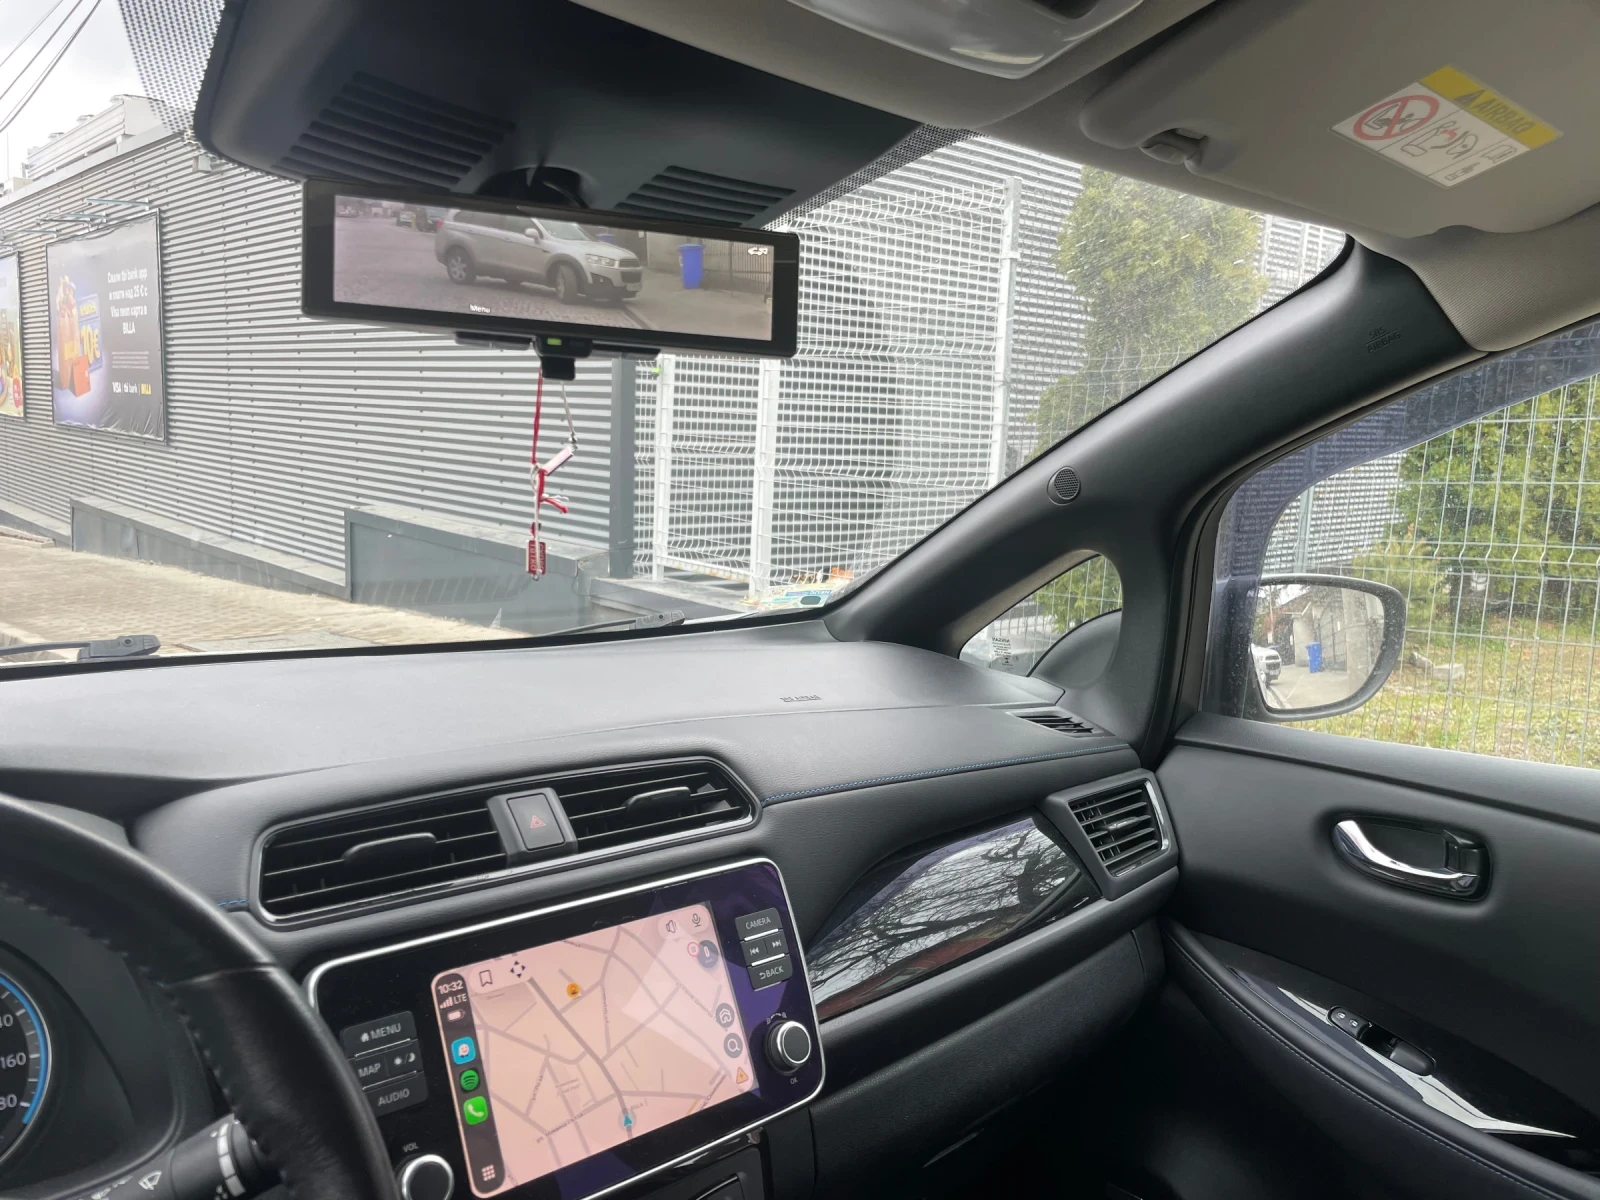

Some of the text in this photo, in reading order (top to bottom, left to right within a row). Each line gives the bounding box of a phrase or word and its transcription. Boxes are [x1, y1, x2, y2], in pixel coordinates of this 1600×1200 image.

[1472, 98, 1535, 134] AIRBAG
[470, 304, 491, 314] Menu
[122, 321, 136, 334] BILLA
[745, 916, 771, 930] CAMERA
[766, 965, 784, 978] BACK
[438, 980, 464, 995] 10:32
[453, 993, 468, 1004] LTE
[370, 1023, 402, 1040] MENU
[0, 1052, 26, 1069] 160
[358, 1063, 381, 1078] MAP
[790, 1077, 798, 1085] OK
[378, 1088, 410, 1106] AUDIO
[402, 1142, 419, 1152] VOL
